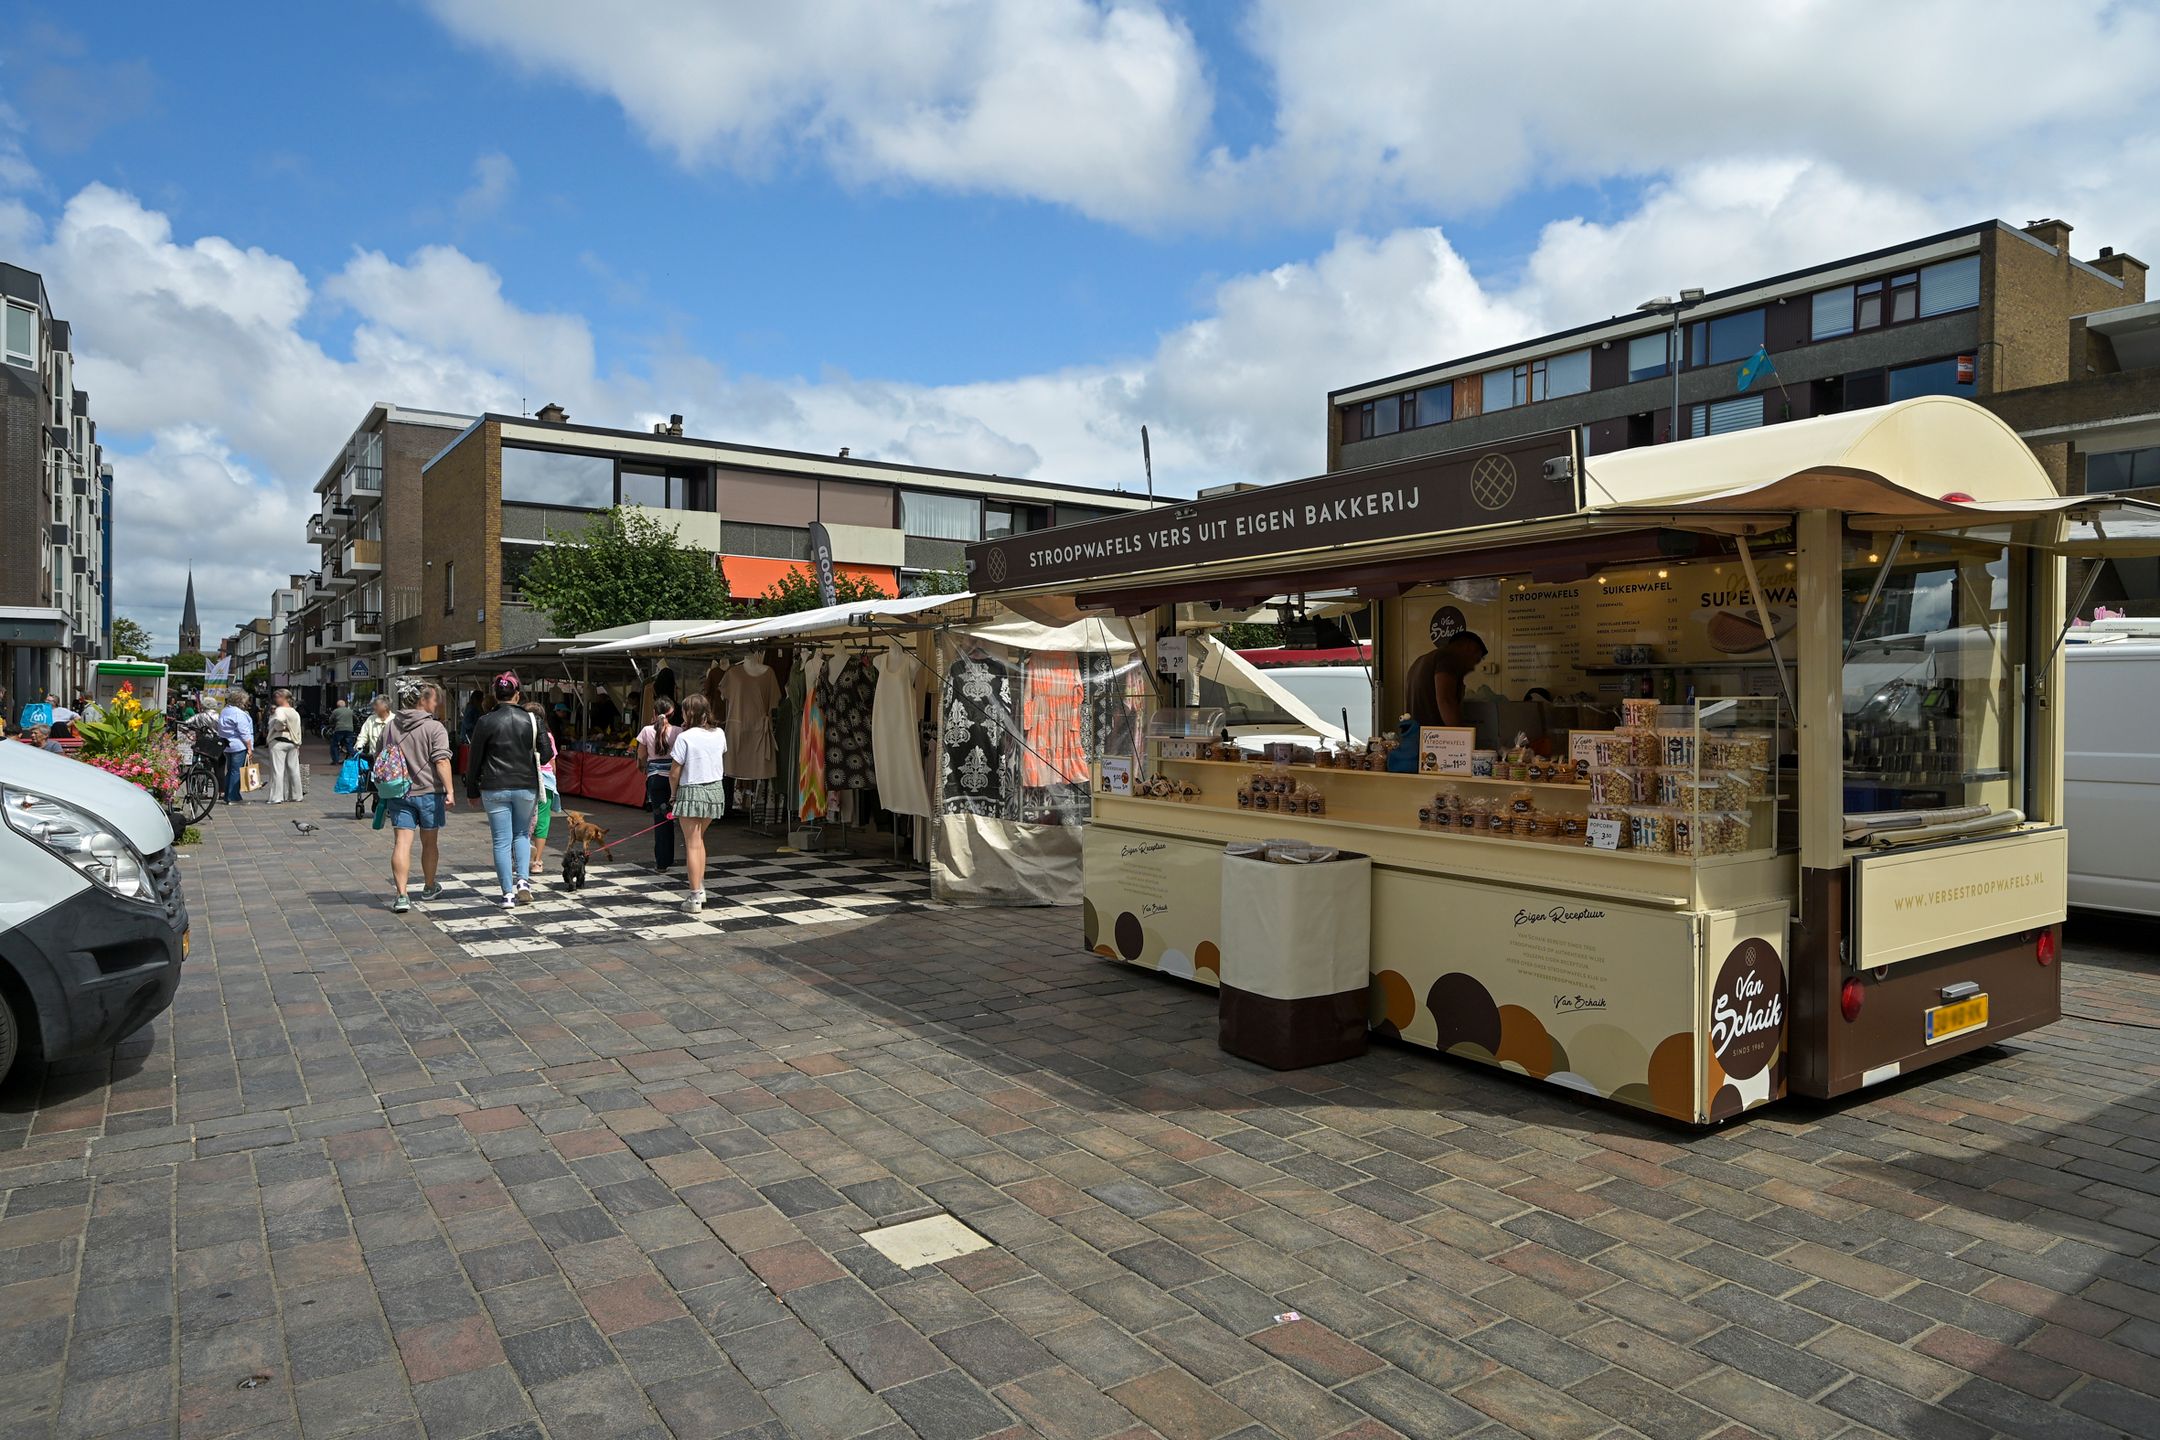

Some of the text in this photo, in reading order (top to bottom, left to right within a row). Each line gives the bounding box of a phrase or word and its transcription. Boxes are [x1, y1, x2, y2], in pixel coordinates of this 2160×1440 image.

[1030, 486, 1420, 567] STROOPWAFELS VERS UIT EIGEN BAKKERIJ
[1509, 589, 1580, 602] STROOPWAFELS
[1602, 582, 1673, 595] SUIKERWAFEL
[1894, 872, 2045, 912] WWW.VERSESTROOPWAFELS.NL
[1514, 906, 1606, 927] Eigen Receptuur
[1735, 970, 1764, 1001] Van
[1554, 995, 1607, 1009] Van Schaik
[1711, 993, 1783, 1059] Schaik
[1732, 1041, 1765, 1057] SINDS 1960
